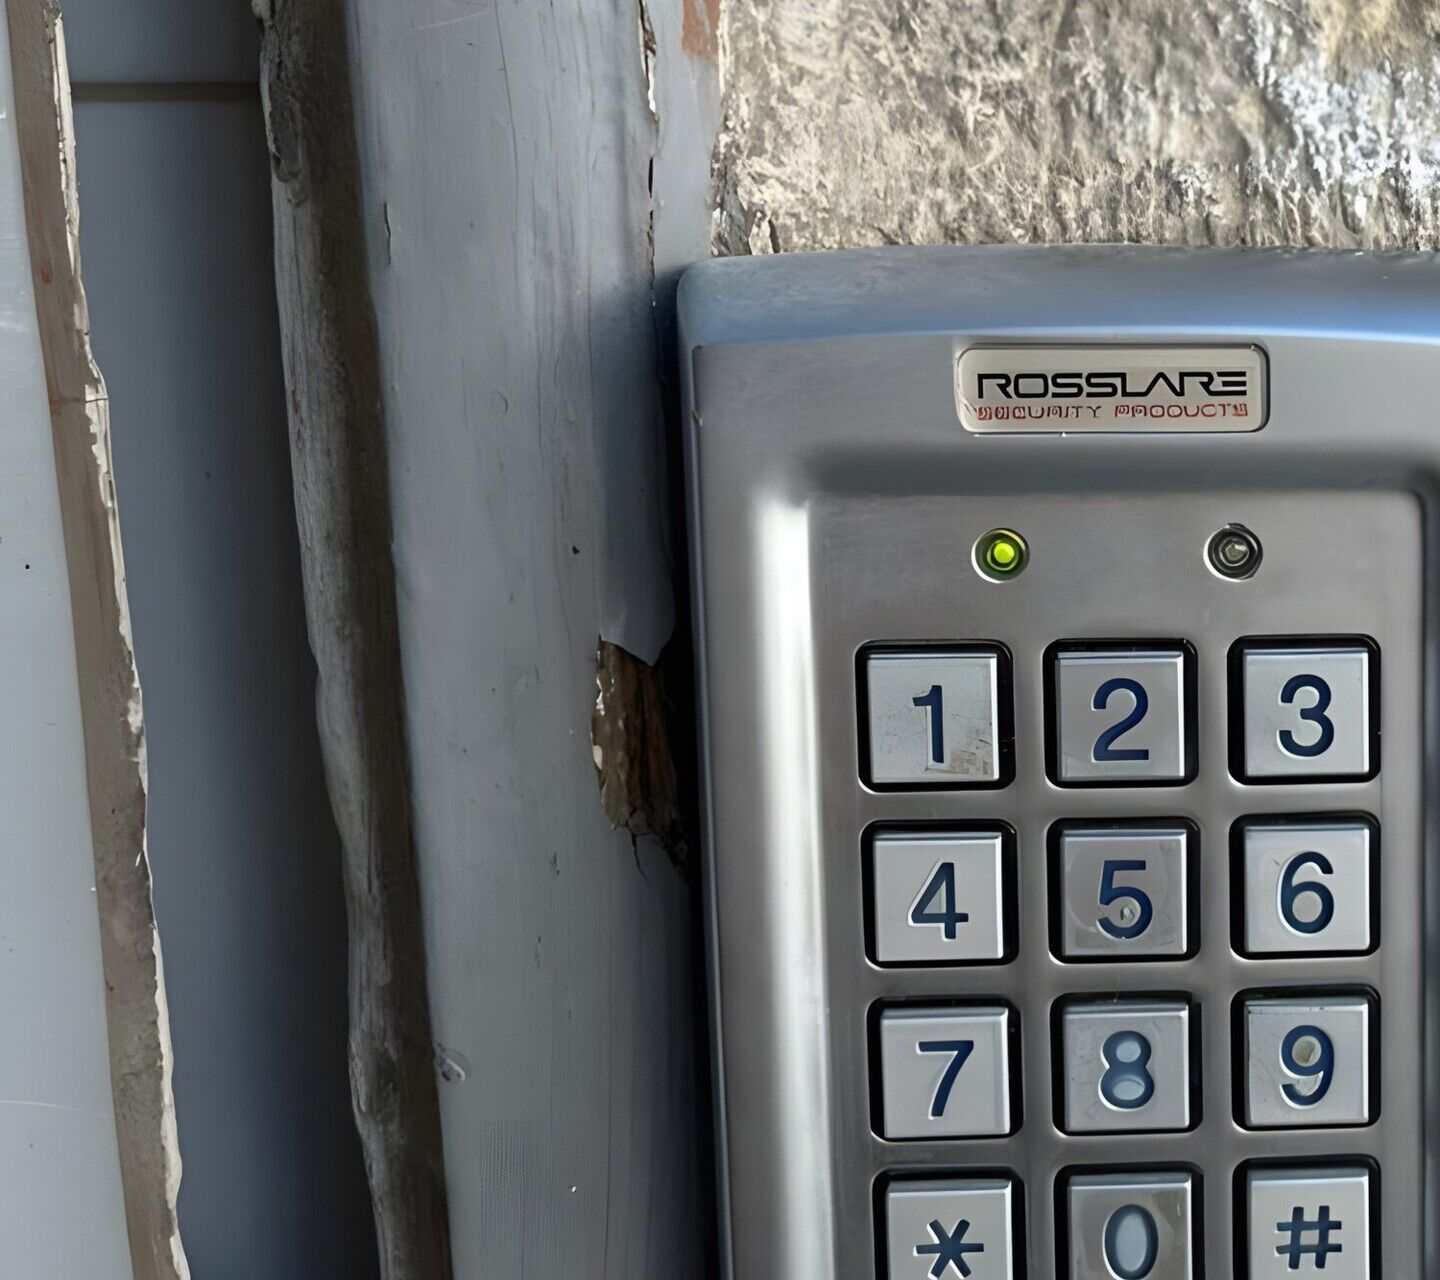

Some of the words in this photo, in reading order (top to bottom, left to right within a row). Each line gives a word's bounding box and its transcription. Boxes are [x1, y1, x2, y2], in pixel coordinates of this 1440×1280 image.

[977, 371, 1247, 399] ROSSLARE
[912, 684, 945, 764] 1
[1093, 677, 1150, 762] 2
[1278, 673, 1335, 758] 3
[910, 861, 969, 940] 4
[1097, 859, 1154, 940] 5
[1280, 851, 1335, 934] 6
[917, 1039, 975, 1117] 7
[1099, 1030, 1156, 1110] 8
[1281, 1024, 1335, 1106] 9
[1275, 1205, 1343, 1270] #
